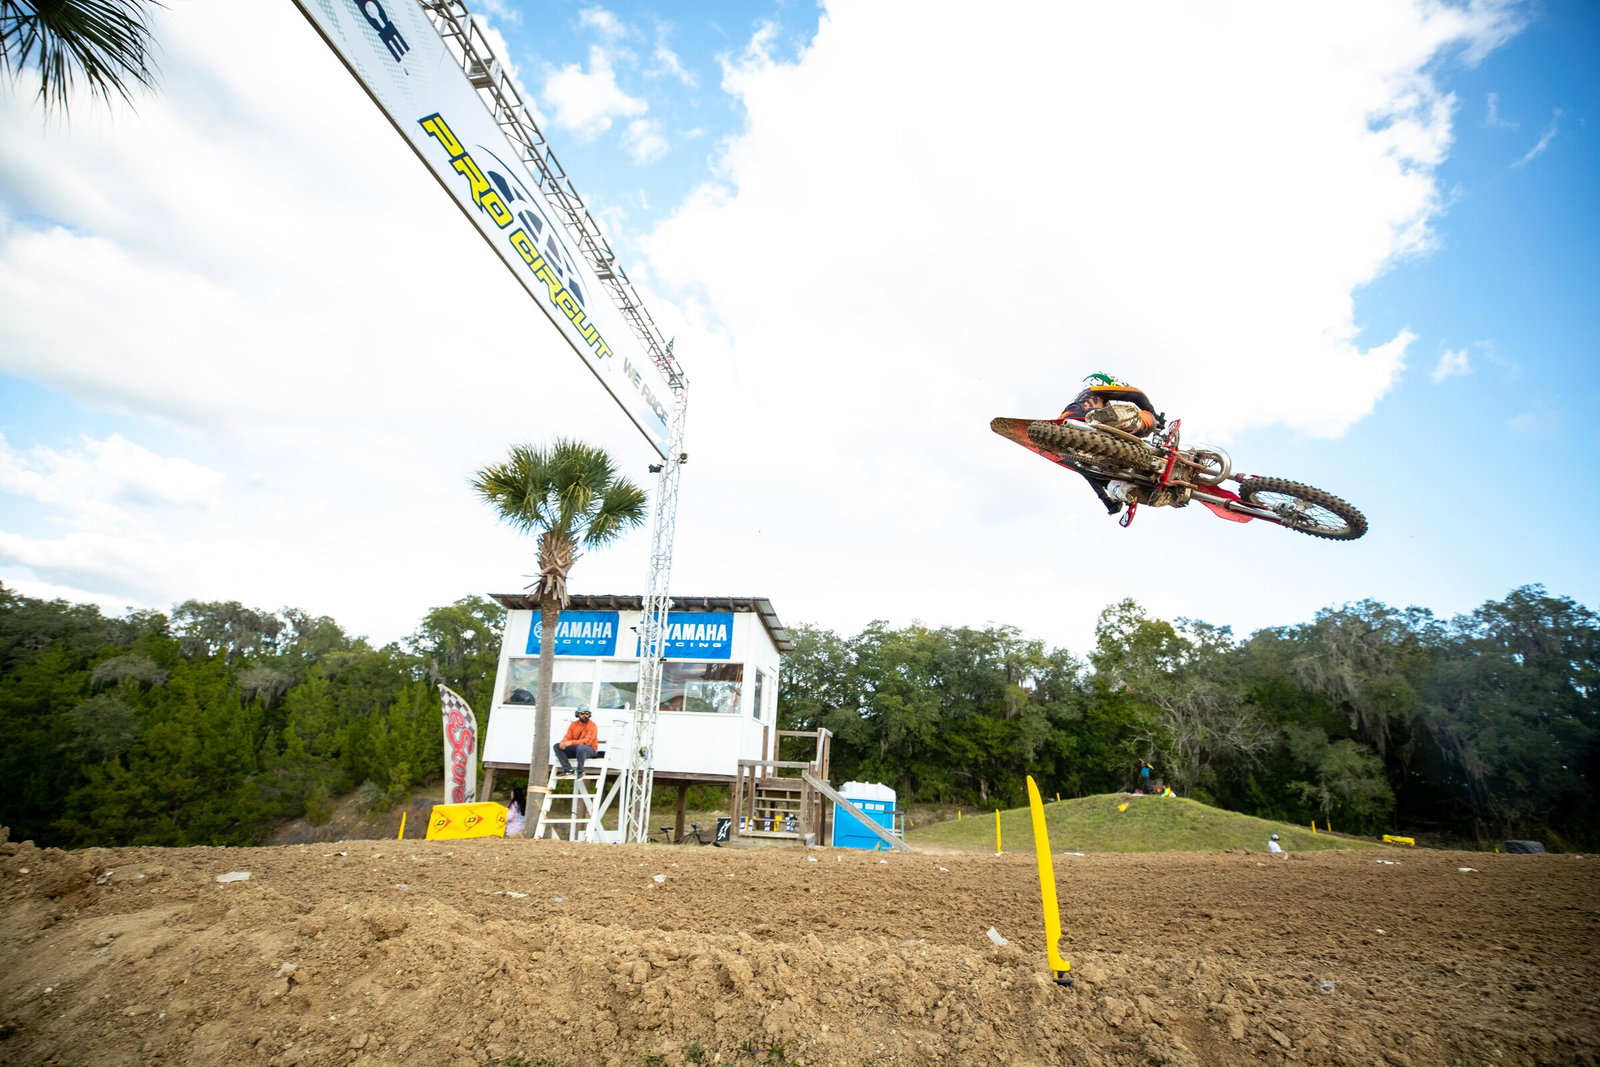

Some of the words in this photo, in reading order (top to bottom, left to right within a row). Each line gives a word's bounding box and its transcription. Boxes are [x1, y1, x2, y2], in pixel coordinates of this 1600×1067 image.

[353, 0, 410, 63] CE
[417, 112, 514, 230] PRO
[509, 227, 613, 359] CIRCUIT
[624, 356, 641, 390] WE
[641, 383, 669, 427] RACE
[554, 621, 612, 638] YAMAHA
[663, 623, 728, 641] YAMAHA
[446, 710, 474, 804] eScore
